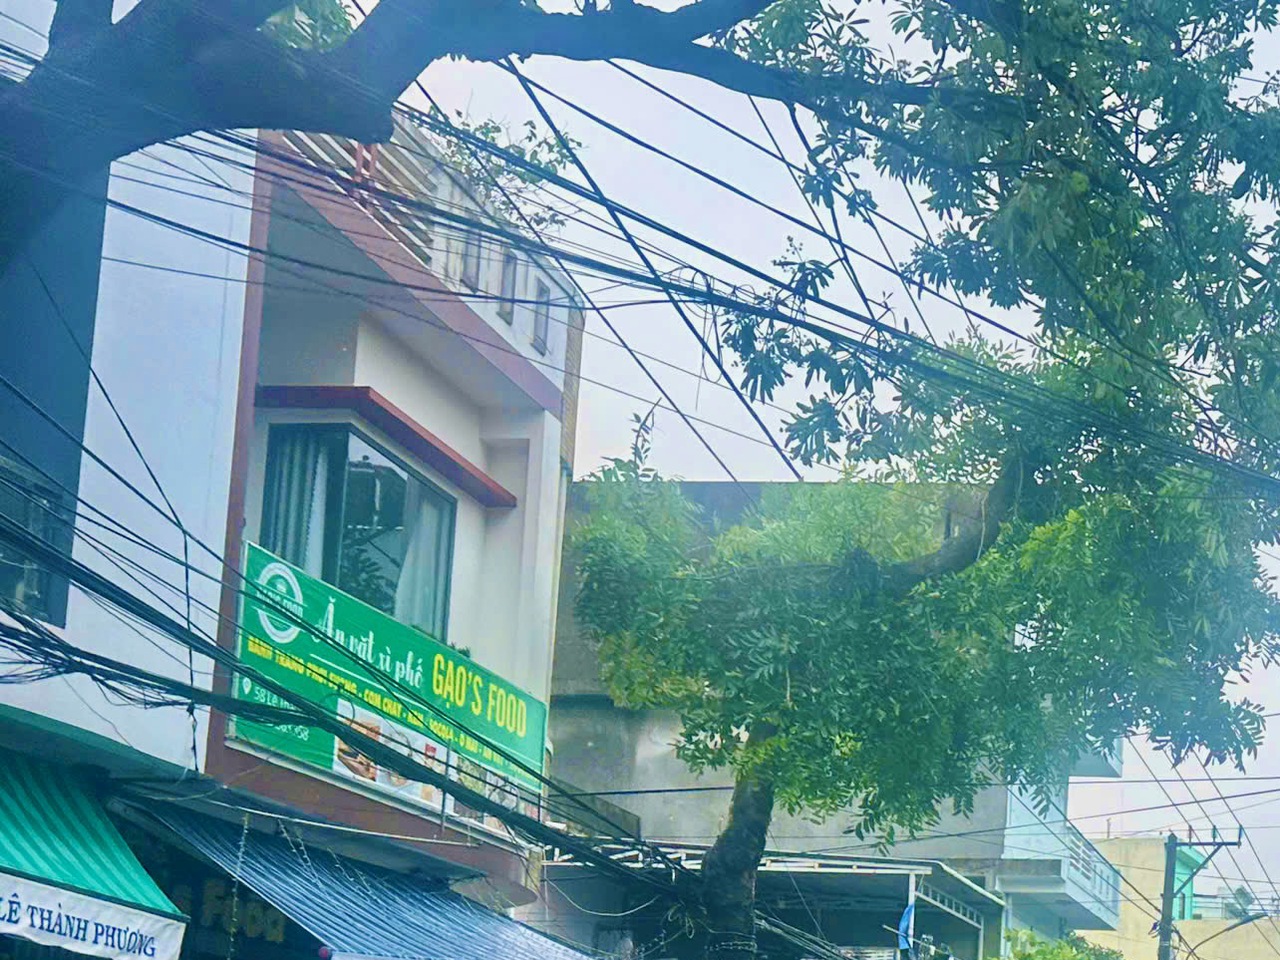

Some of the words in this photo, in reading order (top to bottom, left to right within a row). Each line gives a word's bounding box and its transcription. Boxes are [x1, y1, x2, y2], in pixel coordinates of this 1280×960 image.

[432, 653, 483, 717] GẠO'S
[487, 683, 528, 739] FOOD
[26, 903, 90, 942] THÀNH
[92, 922, 157, 958] PHƯƠNG
